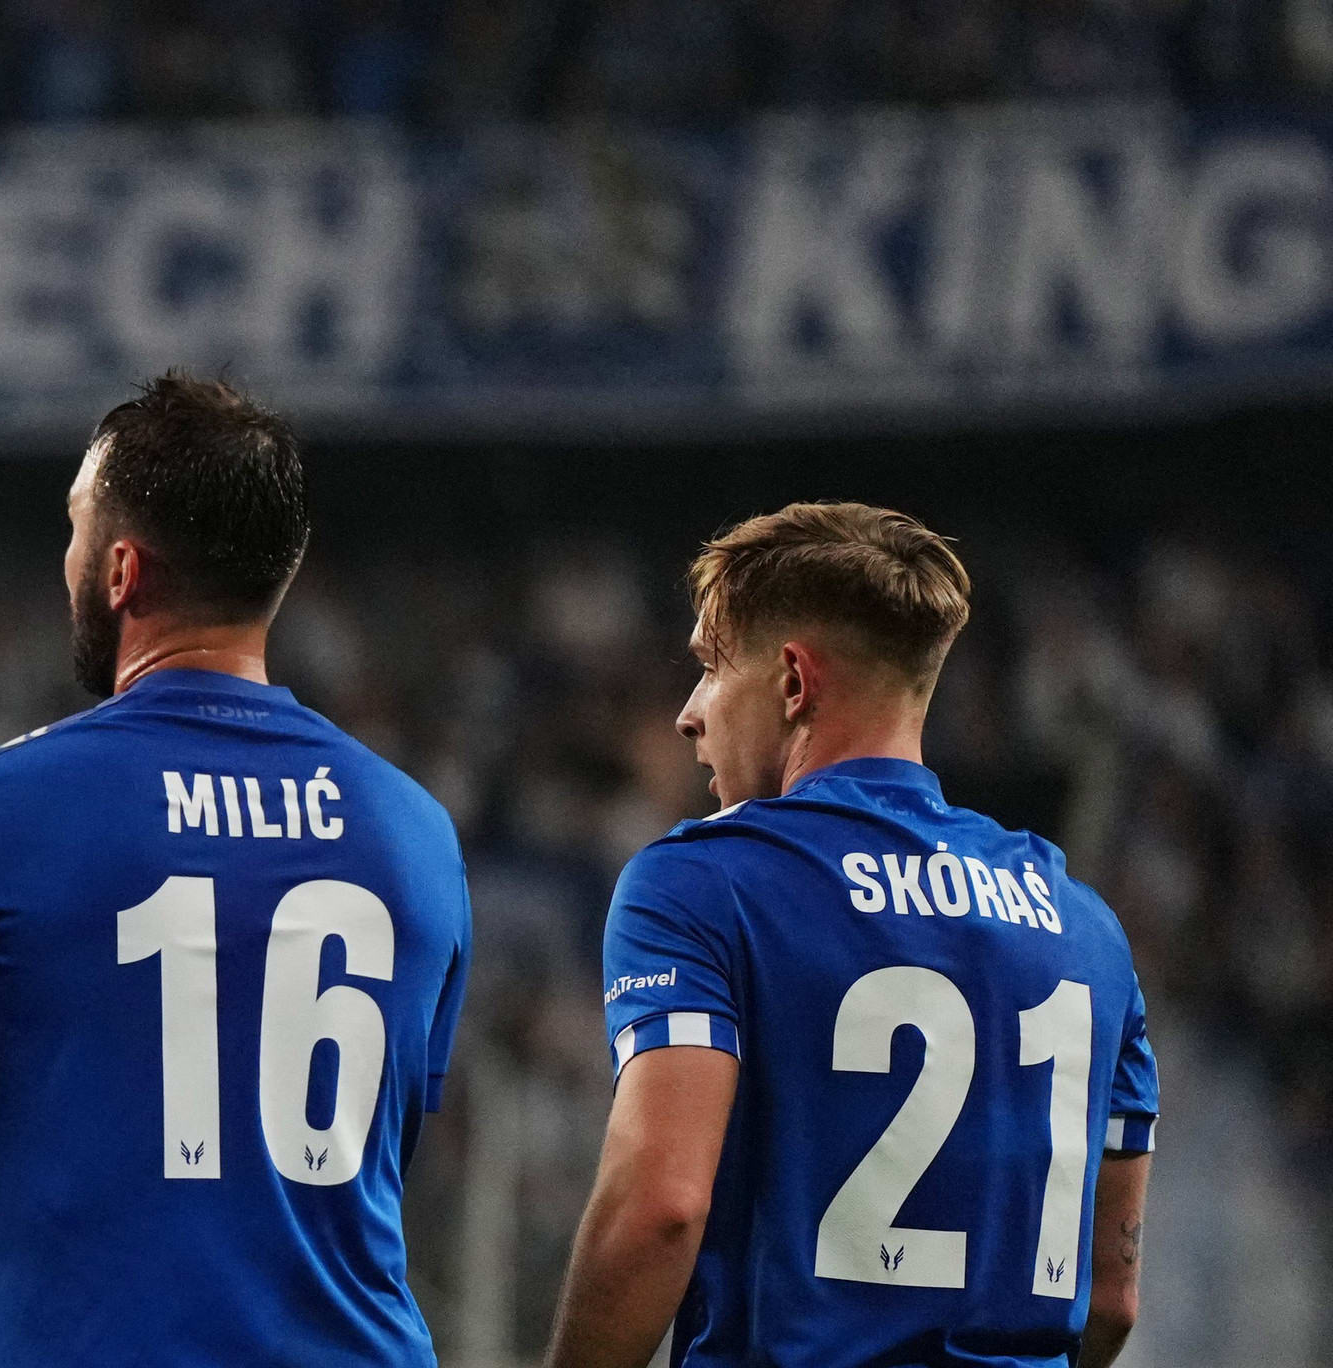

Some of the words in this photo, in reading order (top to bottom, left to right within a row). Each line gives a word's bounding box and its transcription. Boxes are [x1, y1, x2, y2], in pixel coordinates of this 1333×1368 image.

[163, 767, 344, 840] MILIĆ
[841, 843, 1063, 934] SKÓRAŚ
[117, 876, 395, 1186] 16
[814, 966, 1092, 1299] 21
